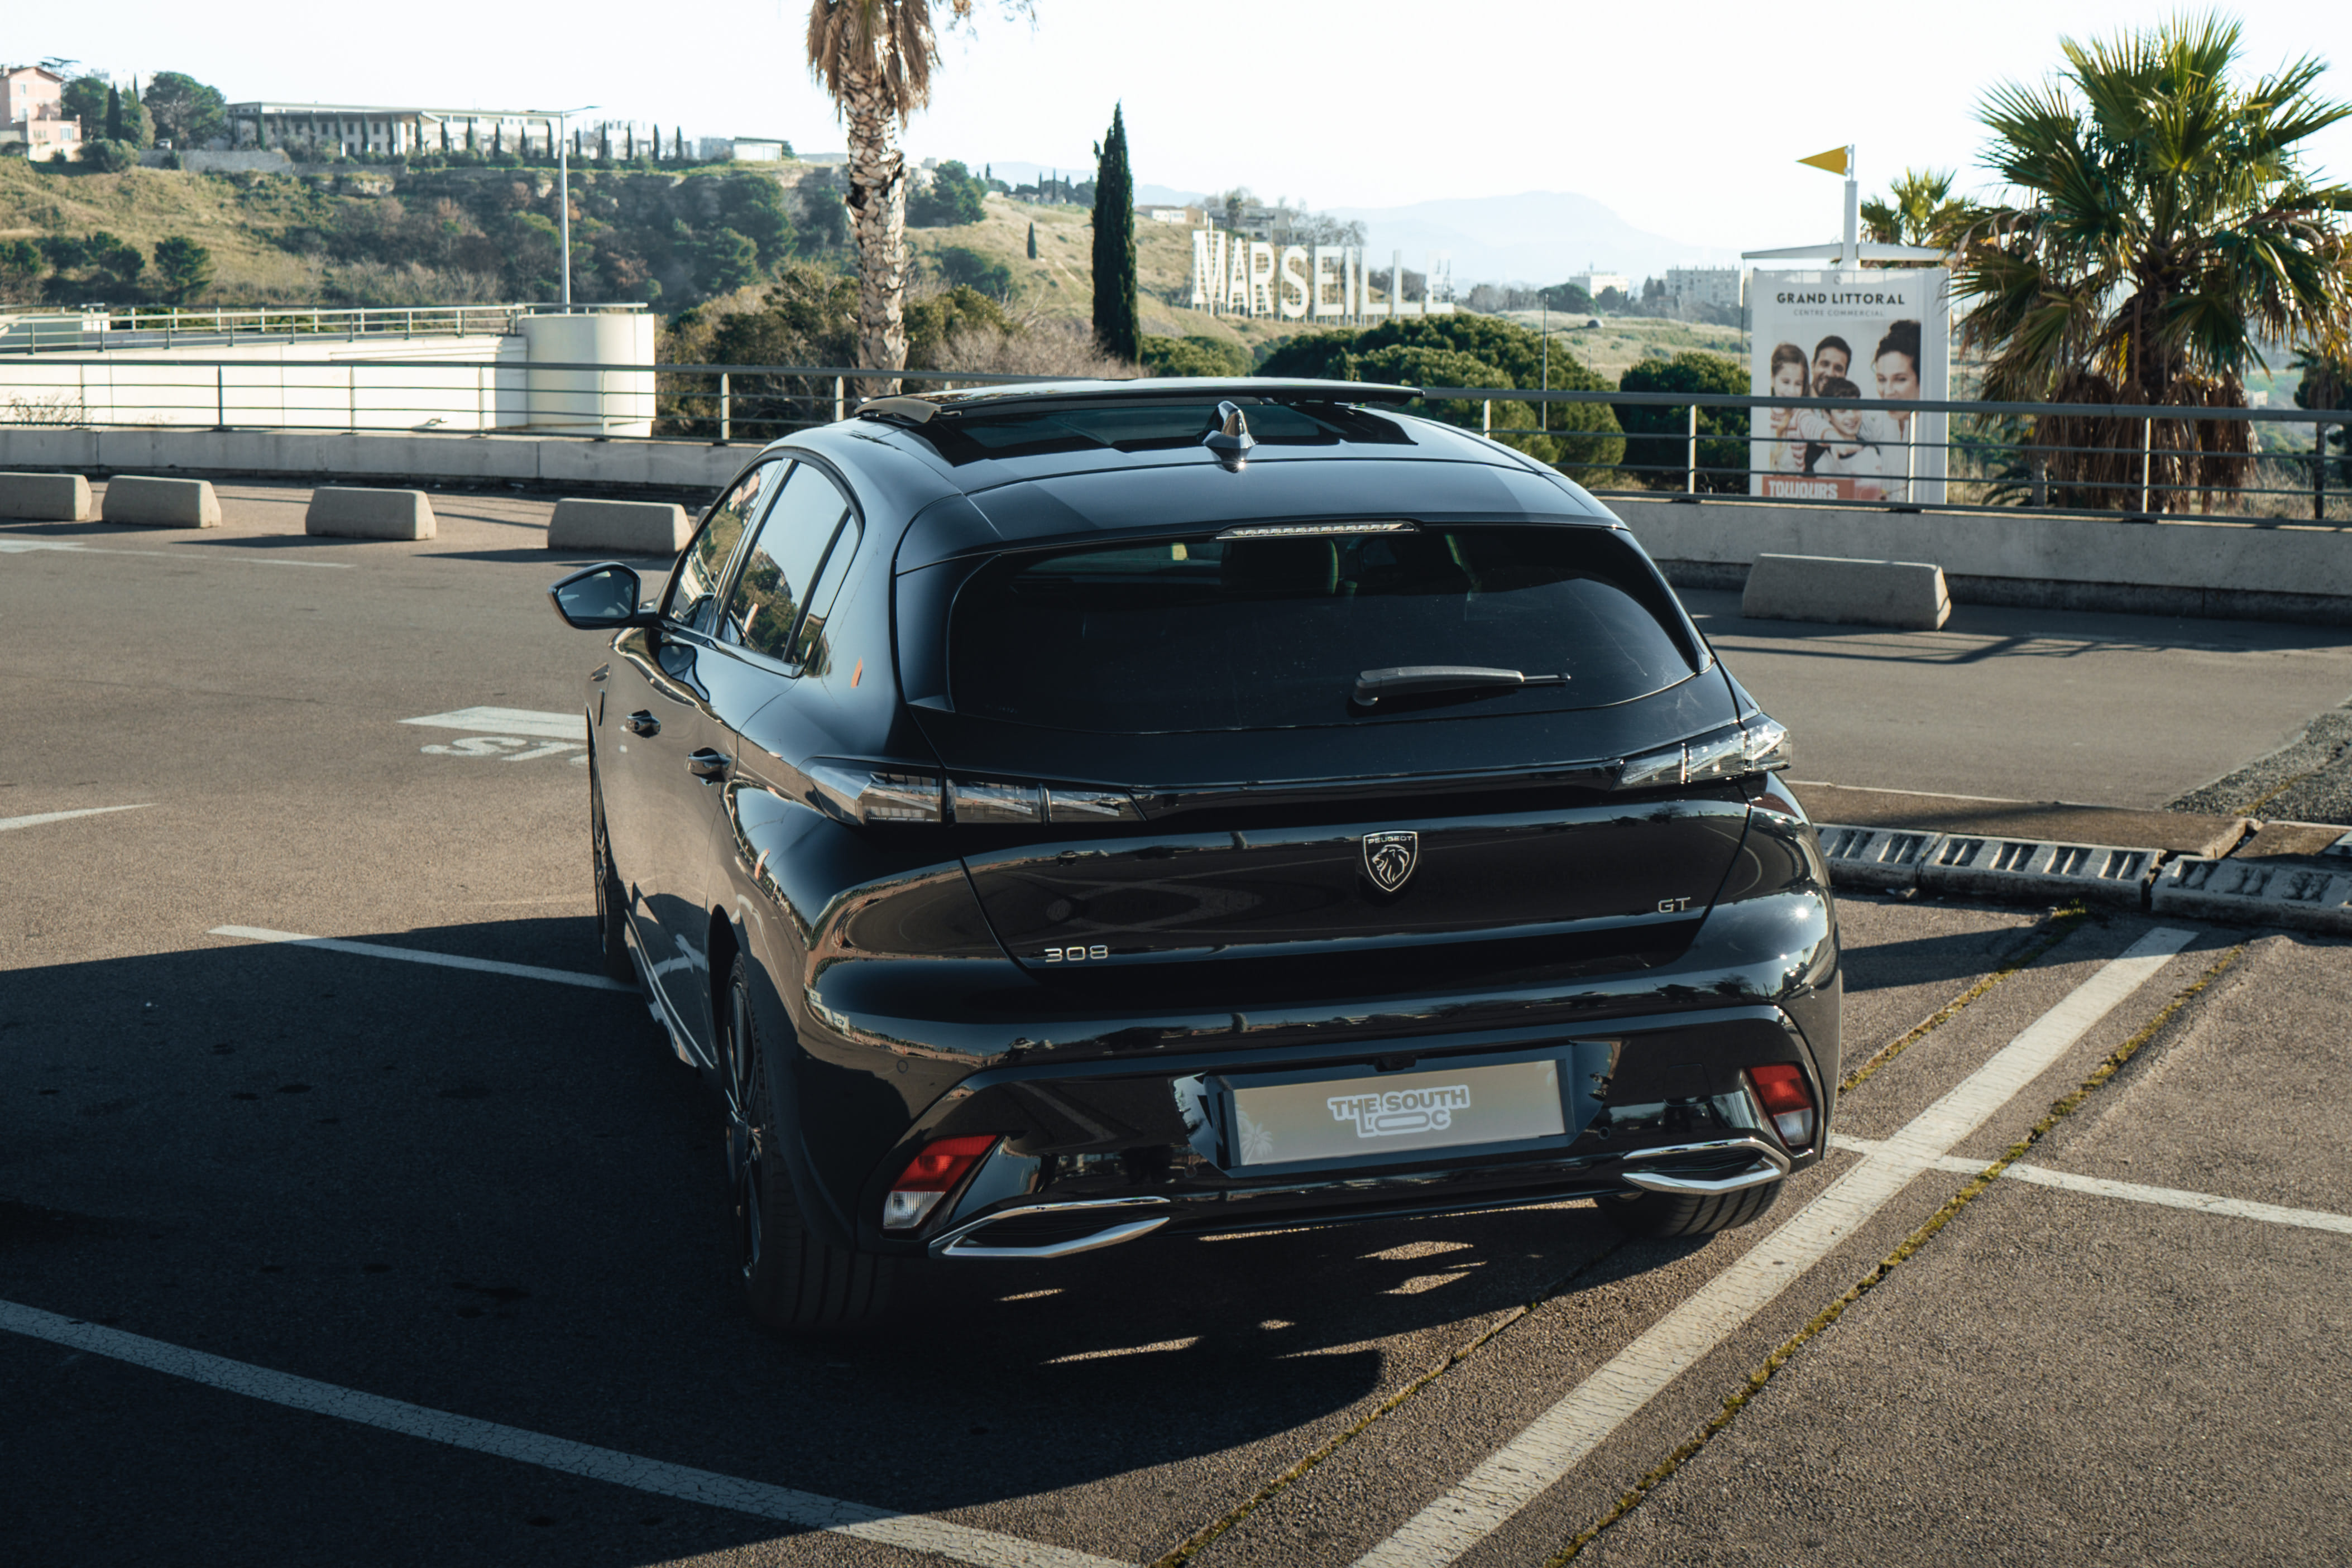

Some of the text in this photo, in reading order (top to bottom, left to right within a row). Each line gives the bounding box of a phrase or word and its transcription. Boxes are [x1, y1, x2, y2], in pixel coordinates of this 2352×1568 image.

[1191, 229, 1455, 319] MARSEILLE
[1776, 292, 1905, 305] GRAND LITTORAL
[1827, 309, 1884, 318] COMMERCIAL
[1768, 480, 1838, 499] TOUJOURS
[1368, 836, 1413, 845] PEUGEOT
[1658, 896, 1691, 913] GT
[1044, 944, 1108, 963] 308
[1330, 1089, 1467, 1117] THE SOUTH
